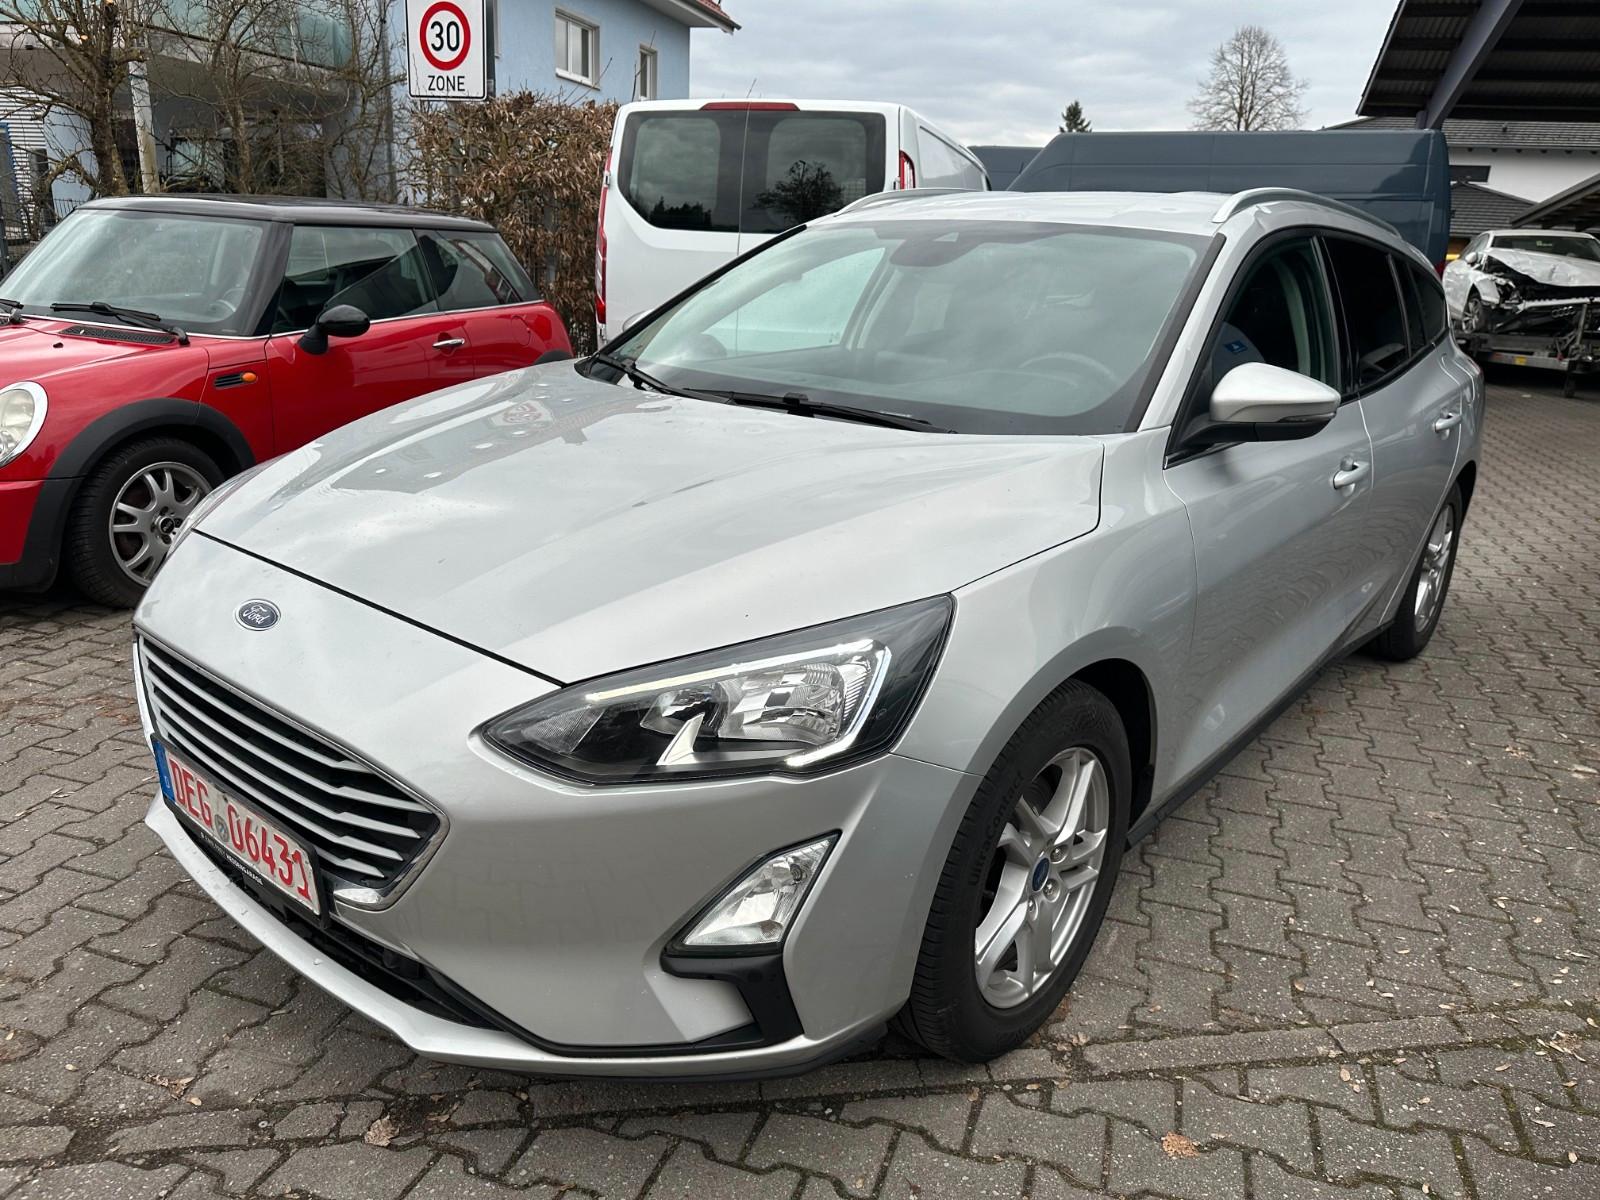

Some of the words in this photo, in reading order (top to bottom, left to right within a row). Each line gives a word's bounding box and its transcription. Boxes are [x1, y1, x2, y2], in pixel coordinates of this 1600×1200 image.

[430, 21, 460, 51] 30
[428, 75, 465, 91] ZONE
[242, 604, 271, 625] Ford
[169, 758, 213, 828] DEG
[227, 802, 312, 901] 06431
[967, 769, 1025, 887] UltraContact
